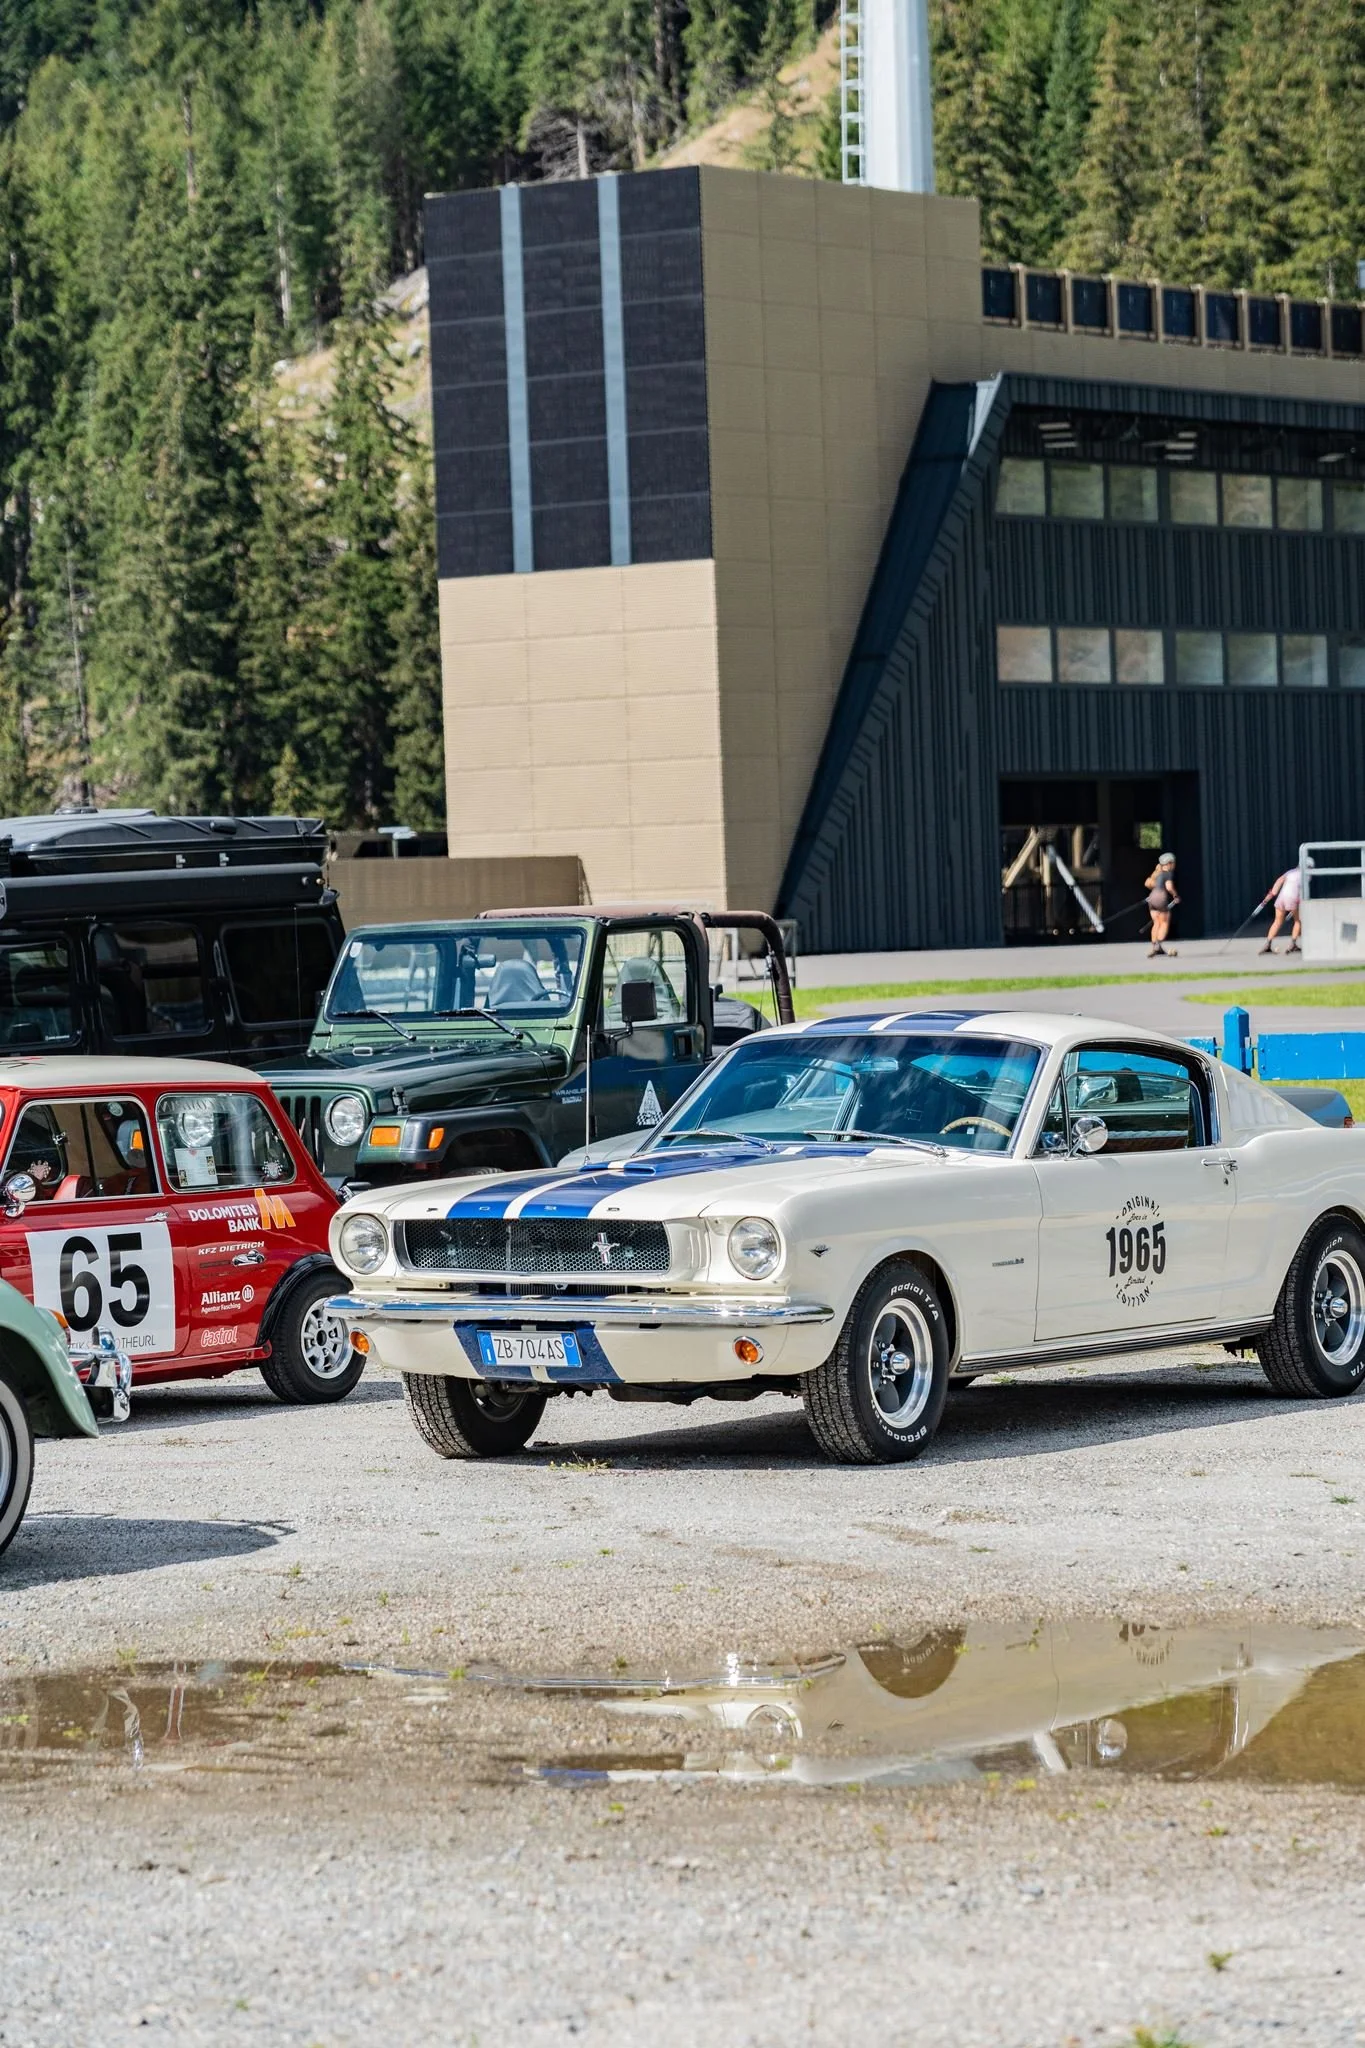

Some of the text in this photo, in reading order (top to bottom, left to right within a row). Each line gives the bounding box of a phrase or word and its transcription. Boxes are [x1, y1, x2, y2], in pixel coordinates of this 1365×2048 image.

[188, 1204, 258, 1222] DOLOMITEN
[1121, 1195, 1160, 1217] ORIGINAL
[227, 1217, 262, 1233] BANK
[198, 1240, 265, 1256] KFZ DIETRICH
[1105, 1221, 1166, 1278] 1965
[60, 1232, 151, 1333] 65
[890, 1282, 924, 1297] Radial
[201, 1290, 241, 1306] Allianz
[1116, 1286, 1150, 1308] EDITION
[121, 1334, 156, 1349] THEURL
[201, 1325, 238, 1348] Castrol
